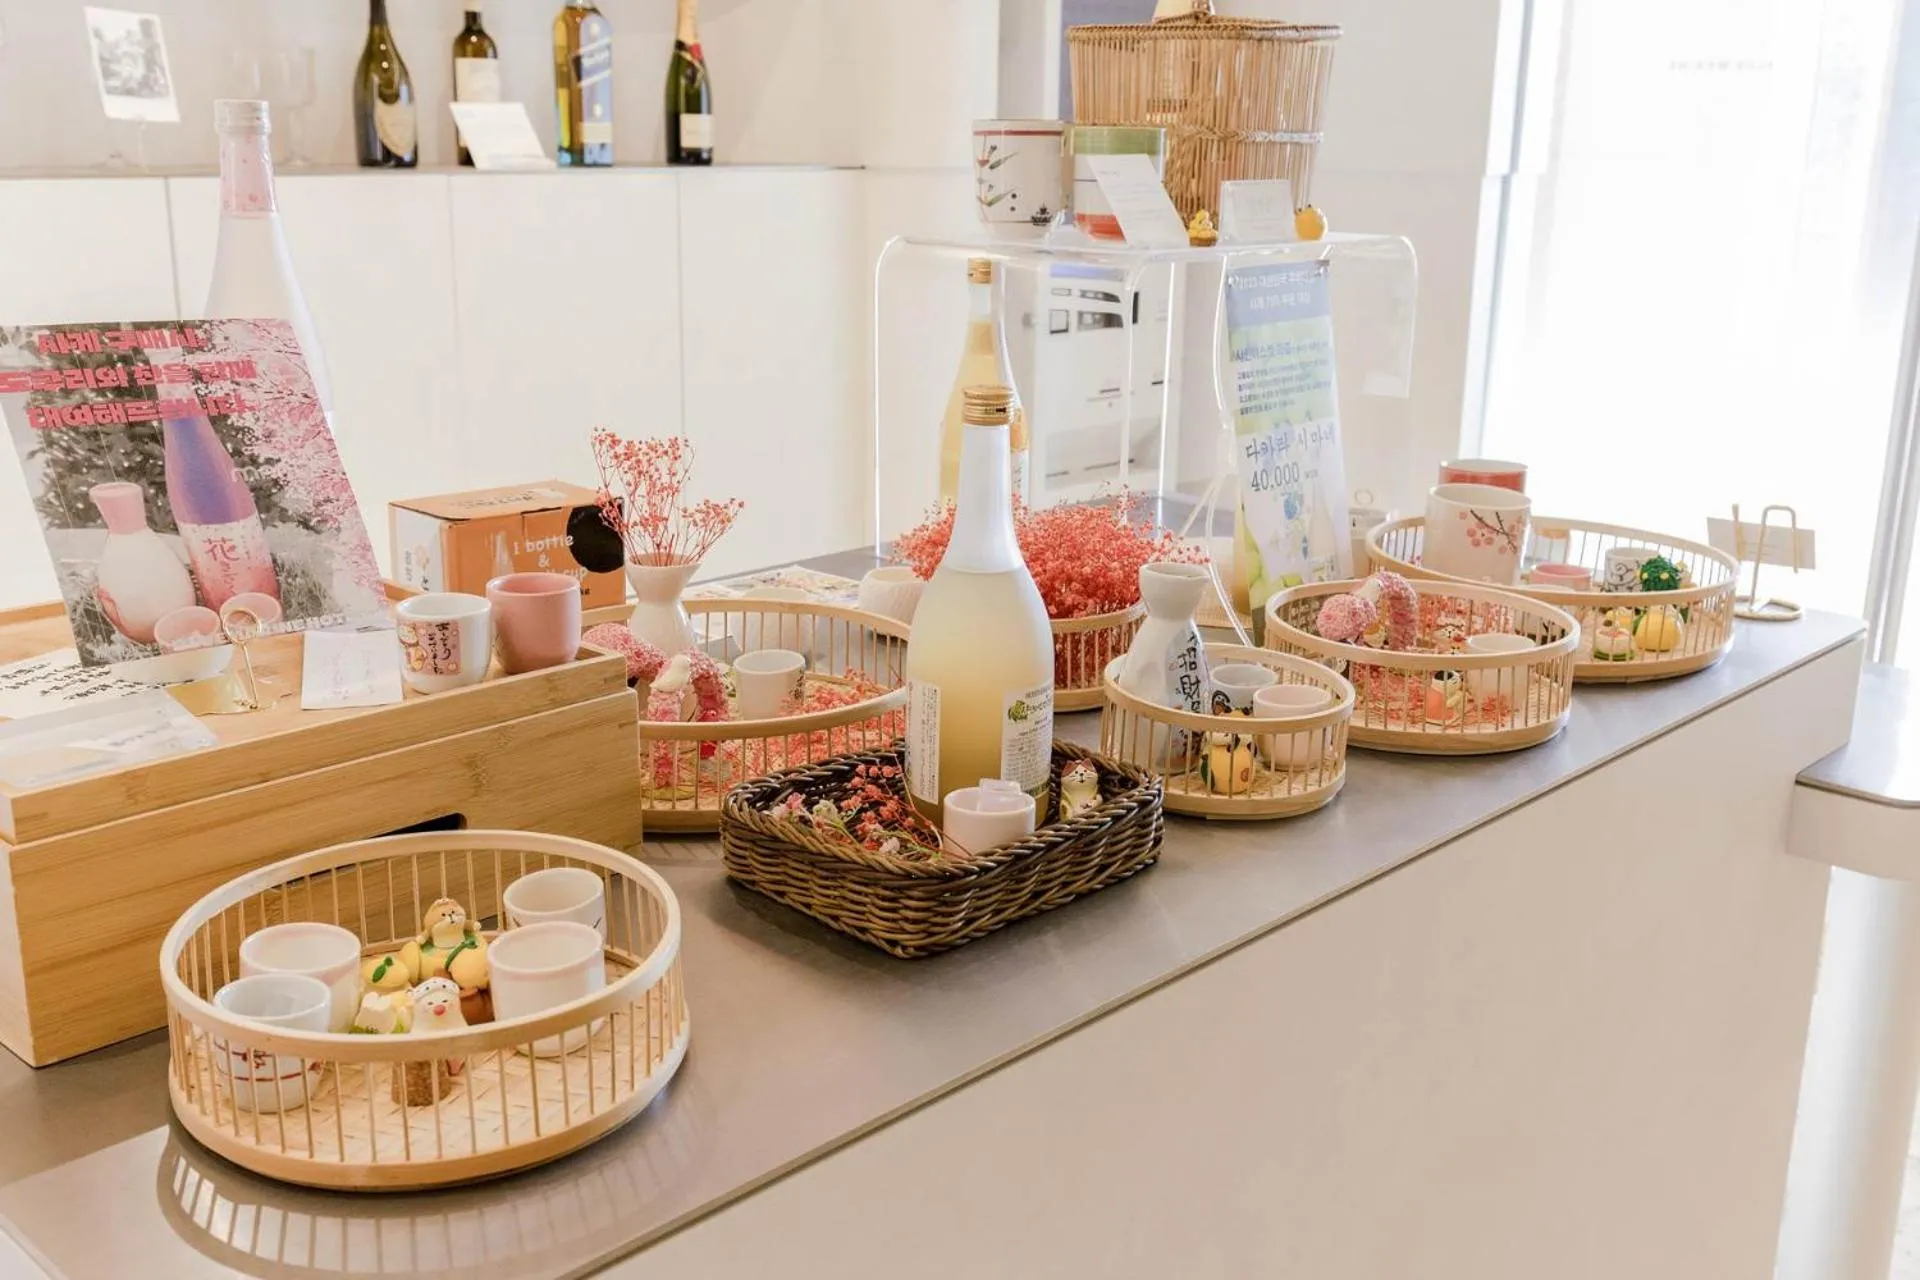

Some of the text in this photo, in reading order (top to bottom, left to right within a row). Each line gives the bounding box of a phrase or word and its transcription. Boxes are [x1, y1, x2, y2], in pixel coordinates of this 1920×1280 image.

[37, 331, 100, 354] 사케
[525, 535, 574, 552] bottle
[538, 553, 551, 568] &
